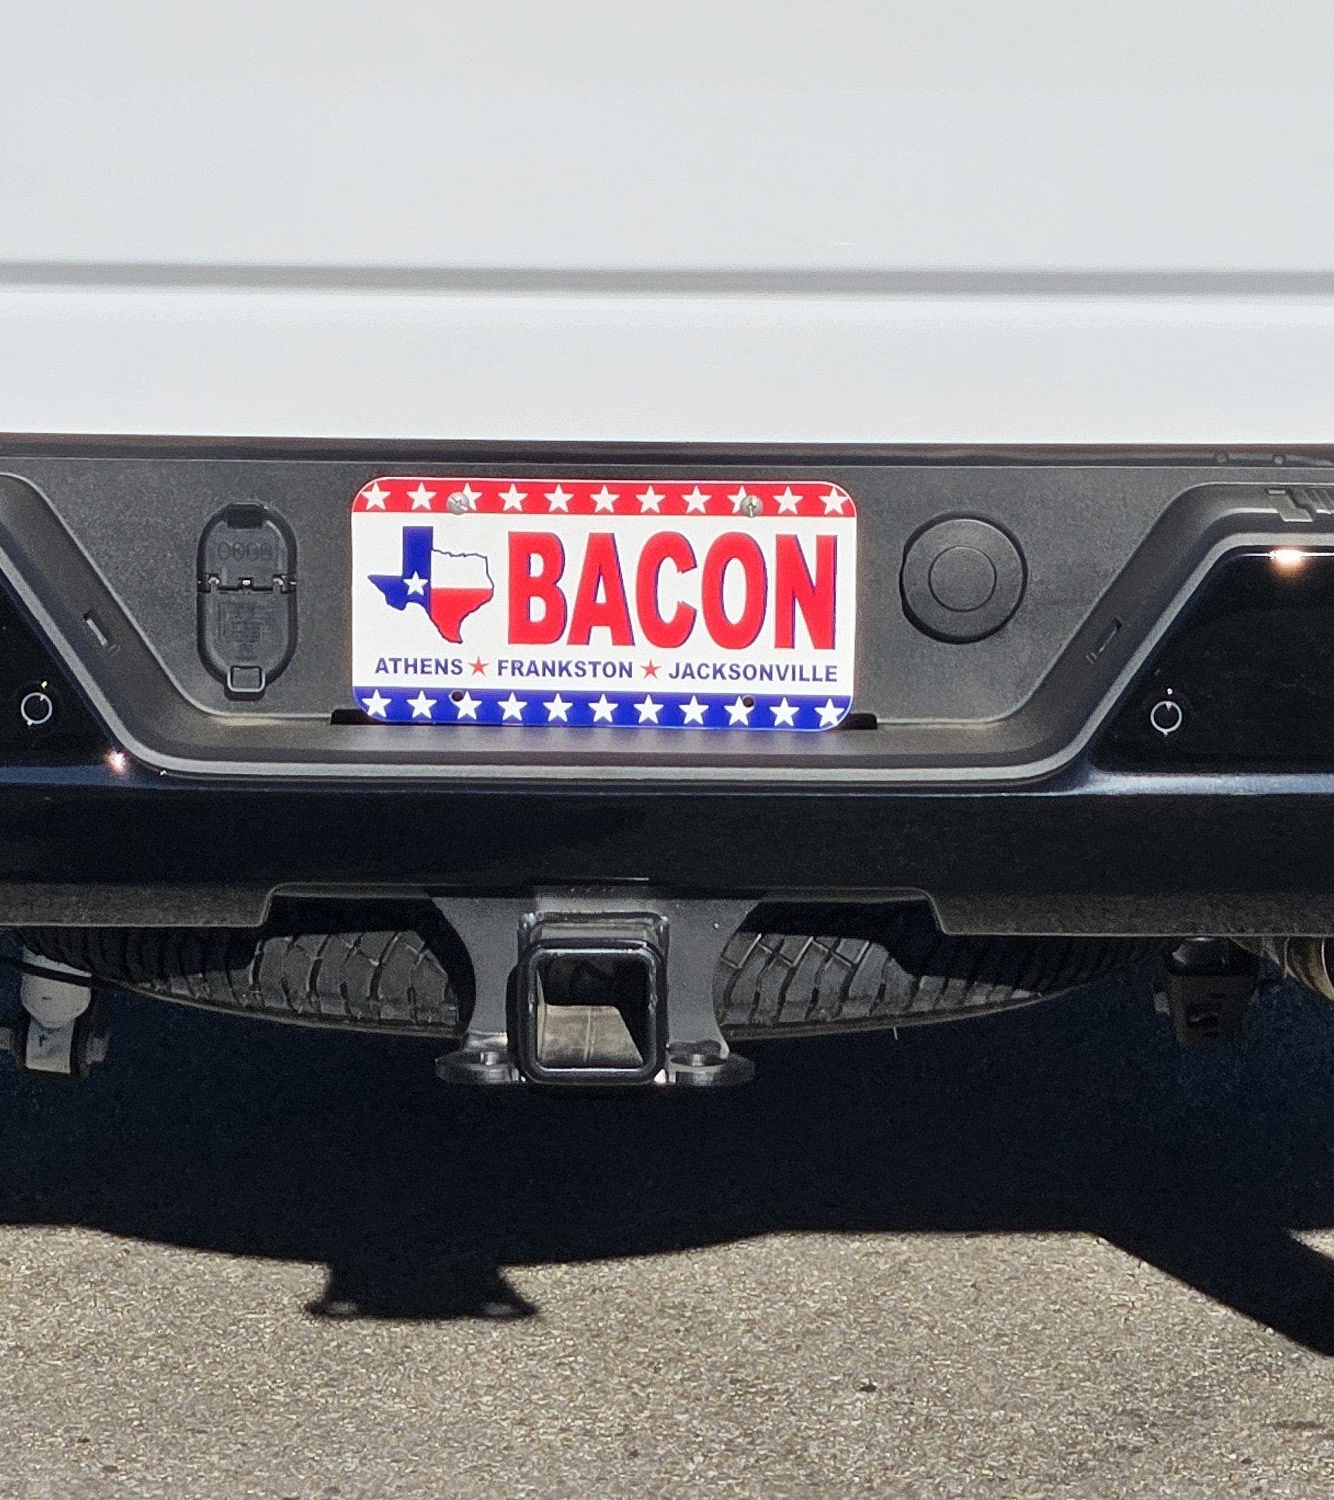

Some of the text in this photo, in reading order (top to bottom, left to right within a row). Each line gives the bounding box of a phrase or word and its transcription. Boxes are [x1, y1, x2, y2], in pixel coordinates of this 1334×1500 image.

[507, 530, 838, 650] BACON
[374, 656, 839, 682] ATHENS FRANKSTON JACKSONVILLE
